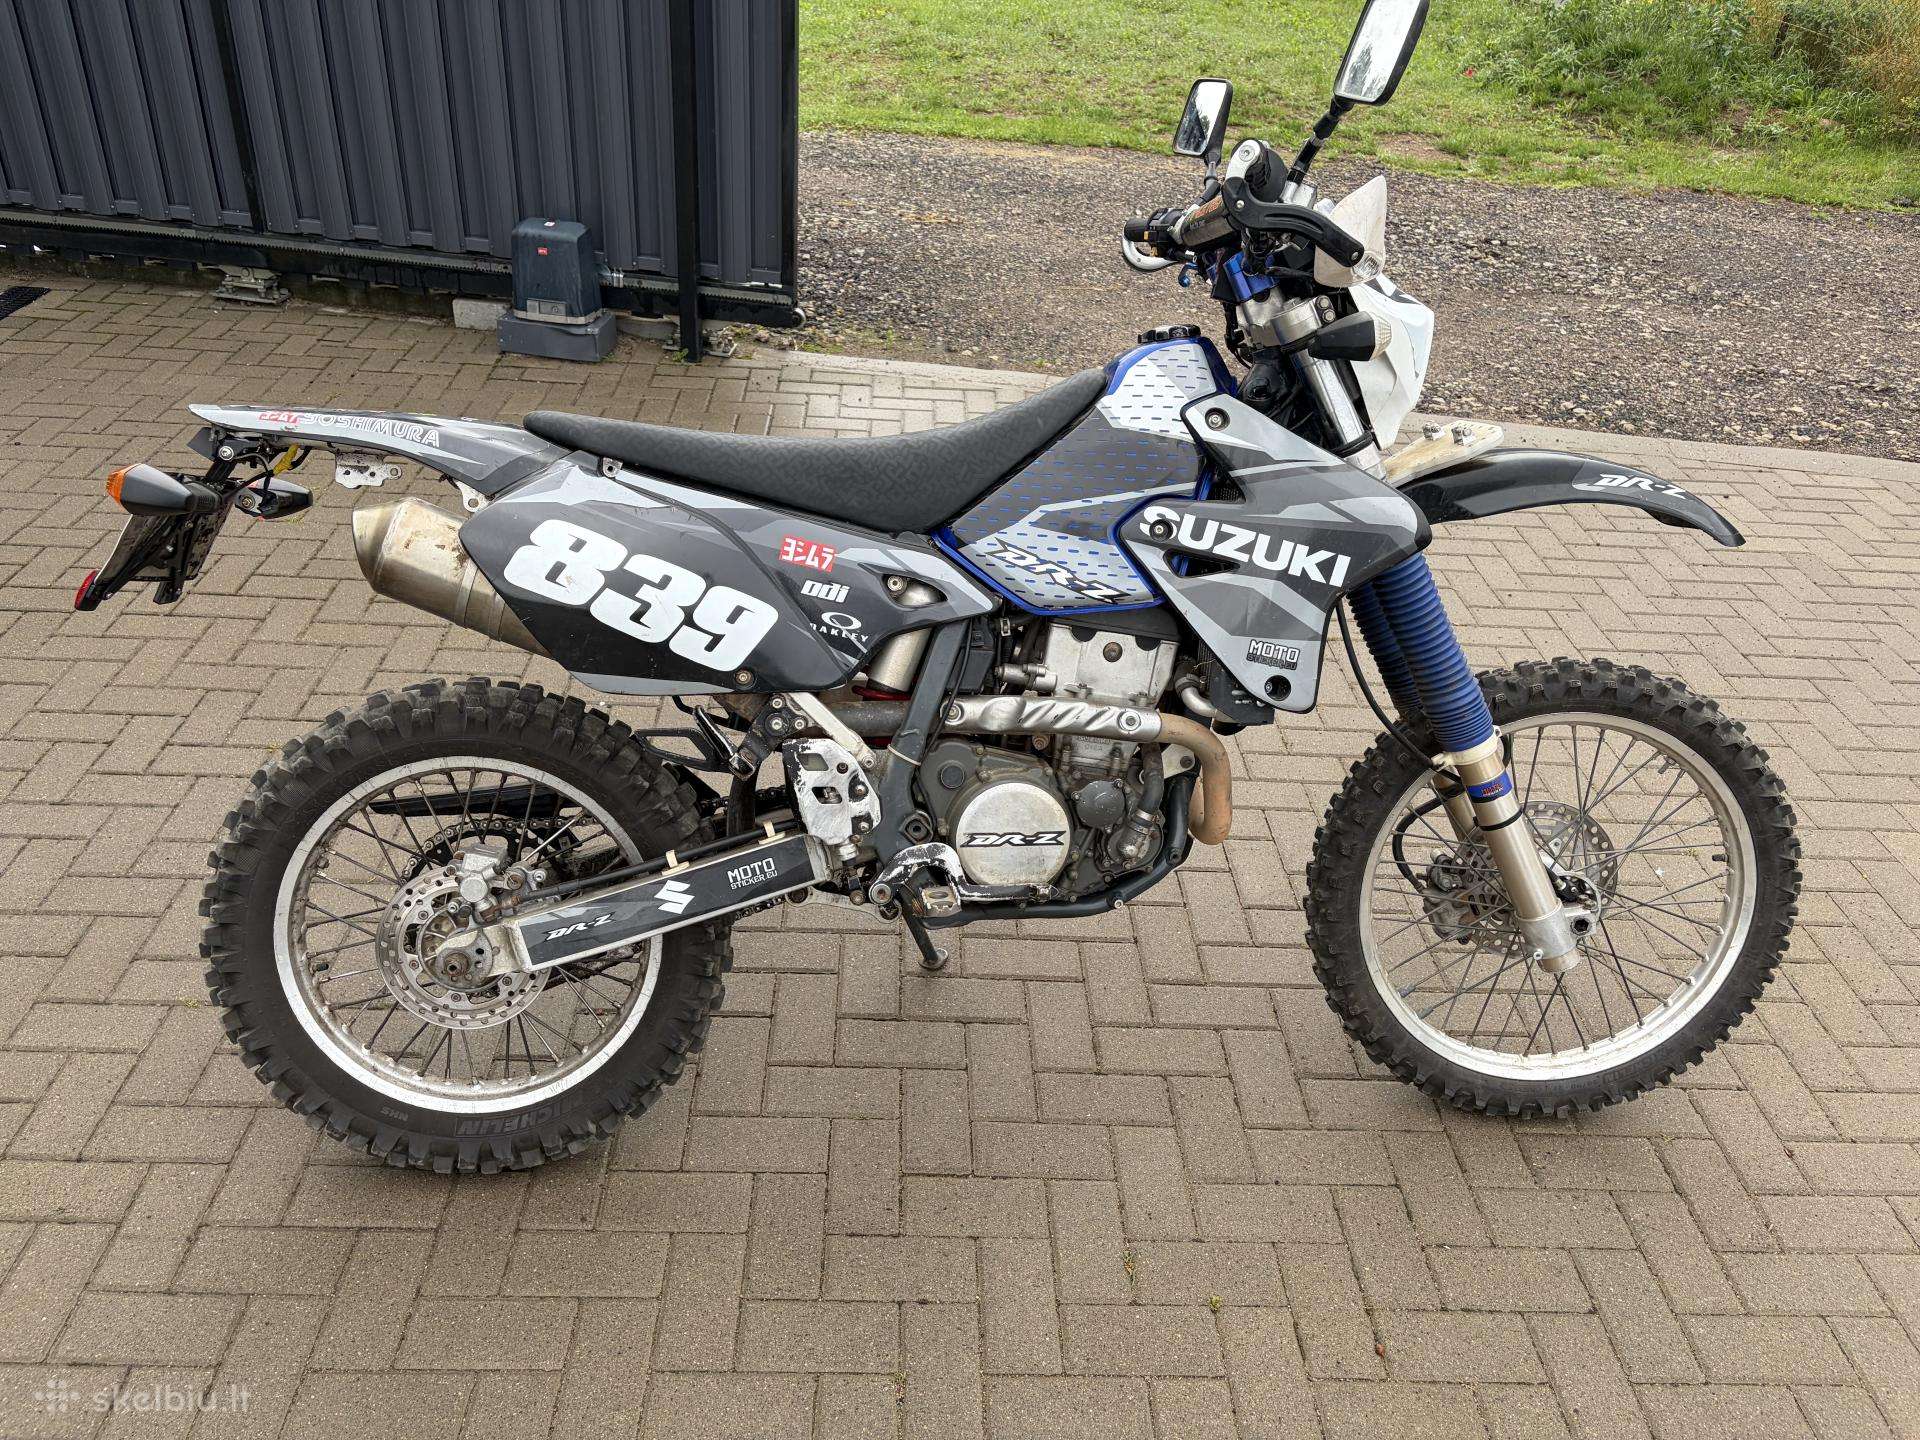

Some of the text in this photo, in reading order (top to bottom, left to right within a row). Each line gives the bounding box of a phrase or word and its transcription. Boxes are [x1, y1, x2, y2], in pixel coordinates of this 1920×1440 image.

[300, 412, 440, 448] YOSHIMURA
[1594, 473, 1687, 500] DR-Z
[780, 536, 836, 571] ヨシムラ
[1140, 505, 1352, 588] SUZUKI
[986, 537, 1130, 603] DR-Z
[503, 518, 779, 672] 839
[800, 579, 851, 604] odi
[1249, 639, 1301, 663] MOTO
[961, 830, 1066, 848] DR-Z
[727, 857, 775, 881] MOTO
[543, 912, 615, 942] DR-Z
